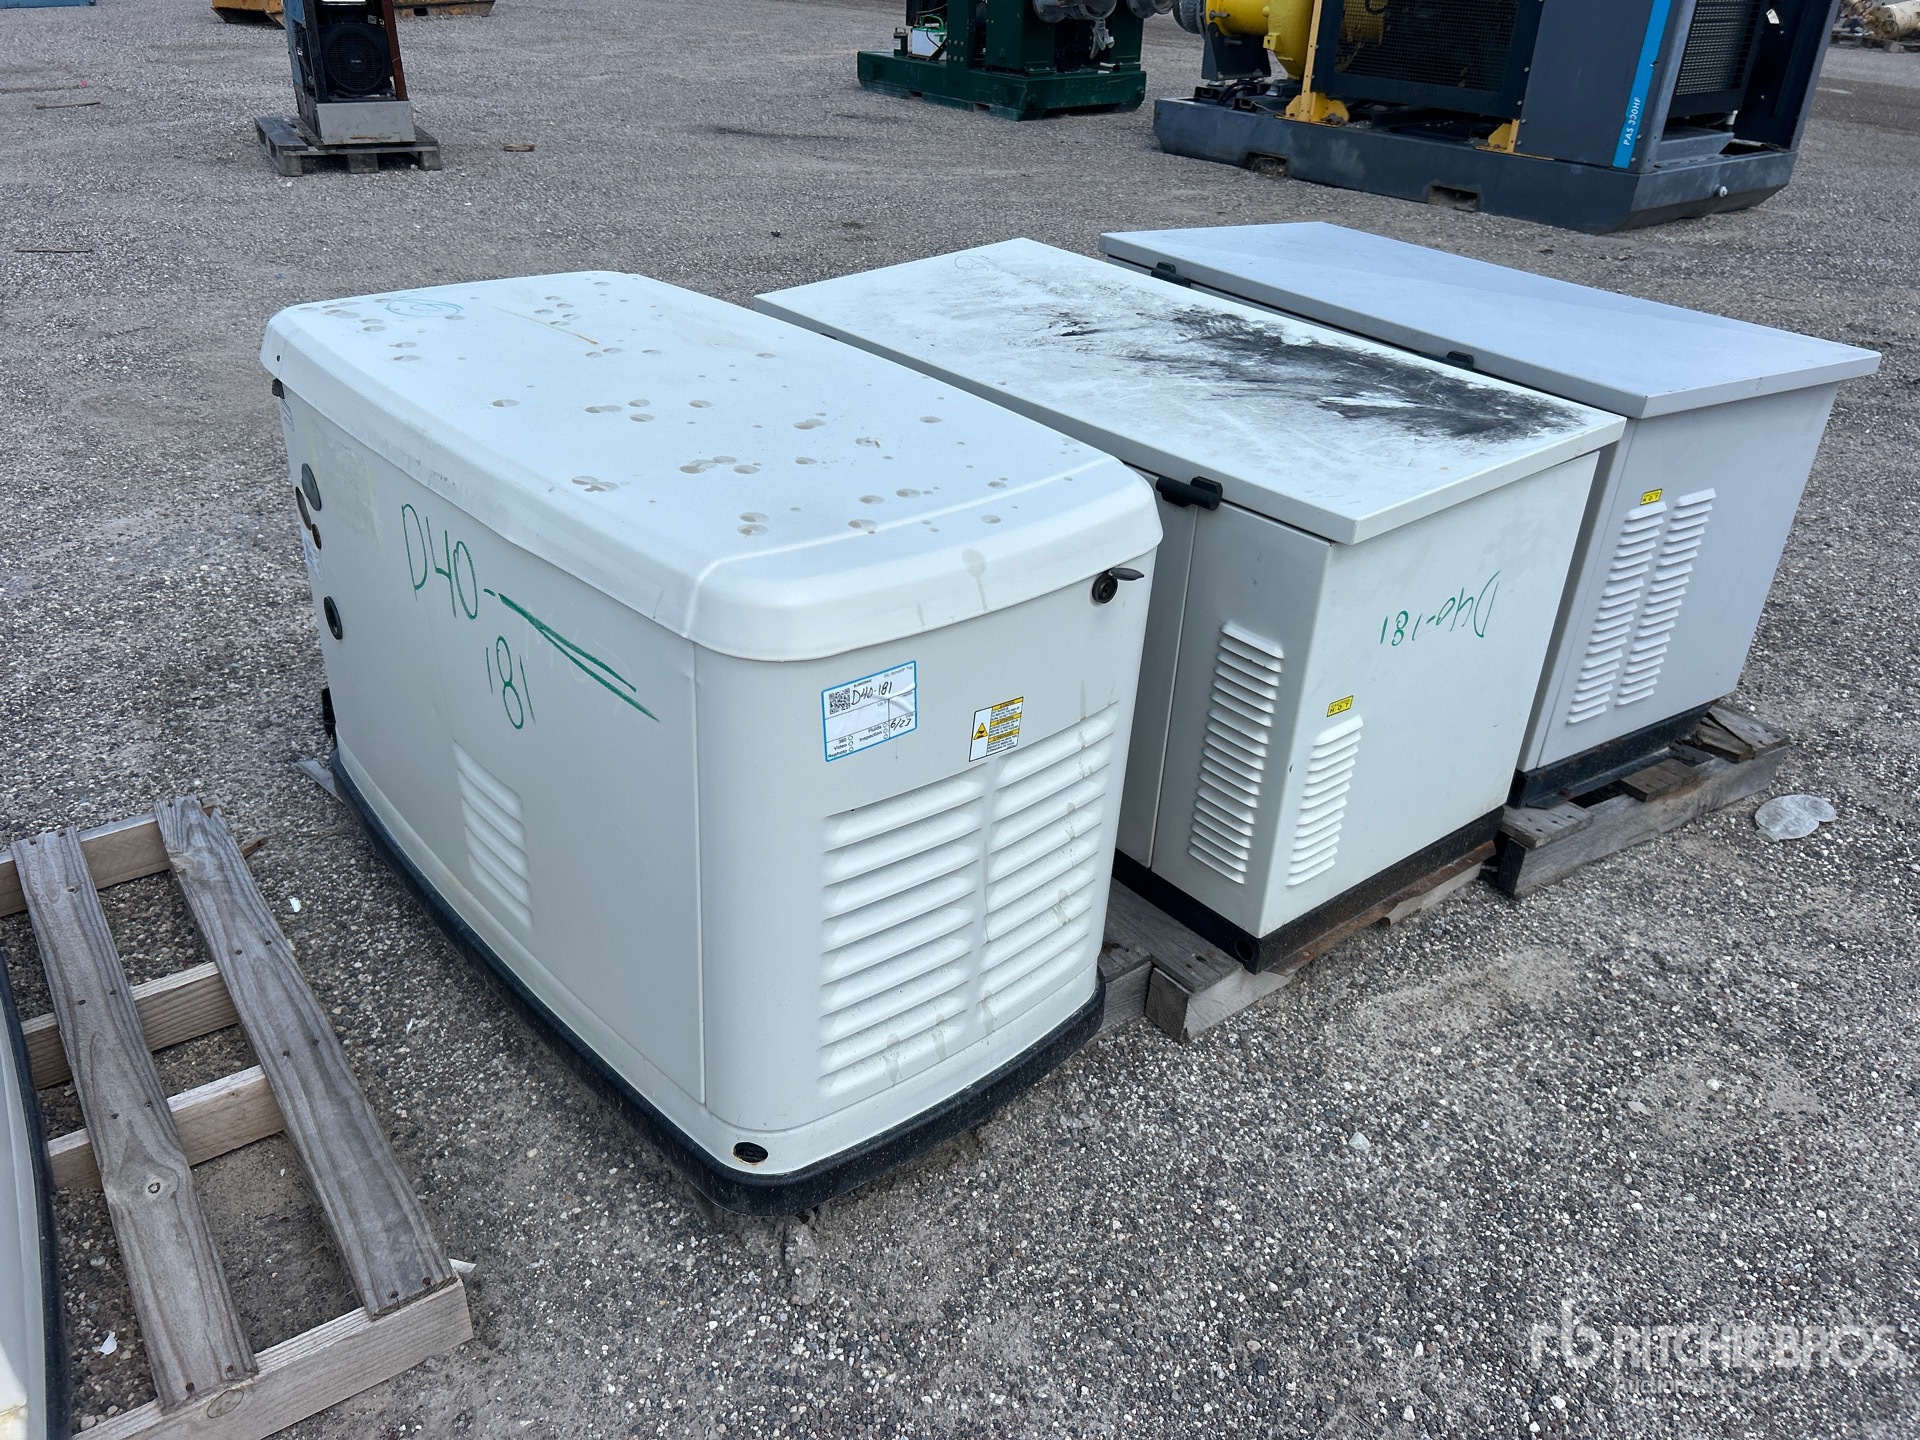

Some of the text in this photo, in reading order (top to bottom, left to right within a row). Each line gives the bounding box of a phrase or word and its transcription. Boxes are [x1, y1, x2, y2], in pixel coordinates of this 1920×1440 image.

[1623, 96, 1641, 146] PAS 300HF
[486, 635, 537, 730] 181
[851, 681, 893, 706] D40-181
[859, 731, 882, 742] Inspection
[868, 725, 882, 733] Fluids
[834, 743, 848, 751] Video
